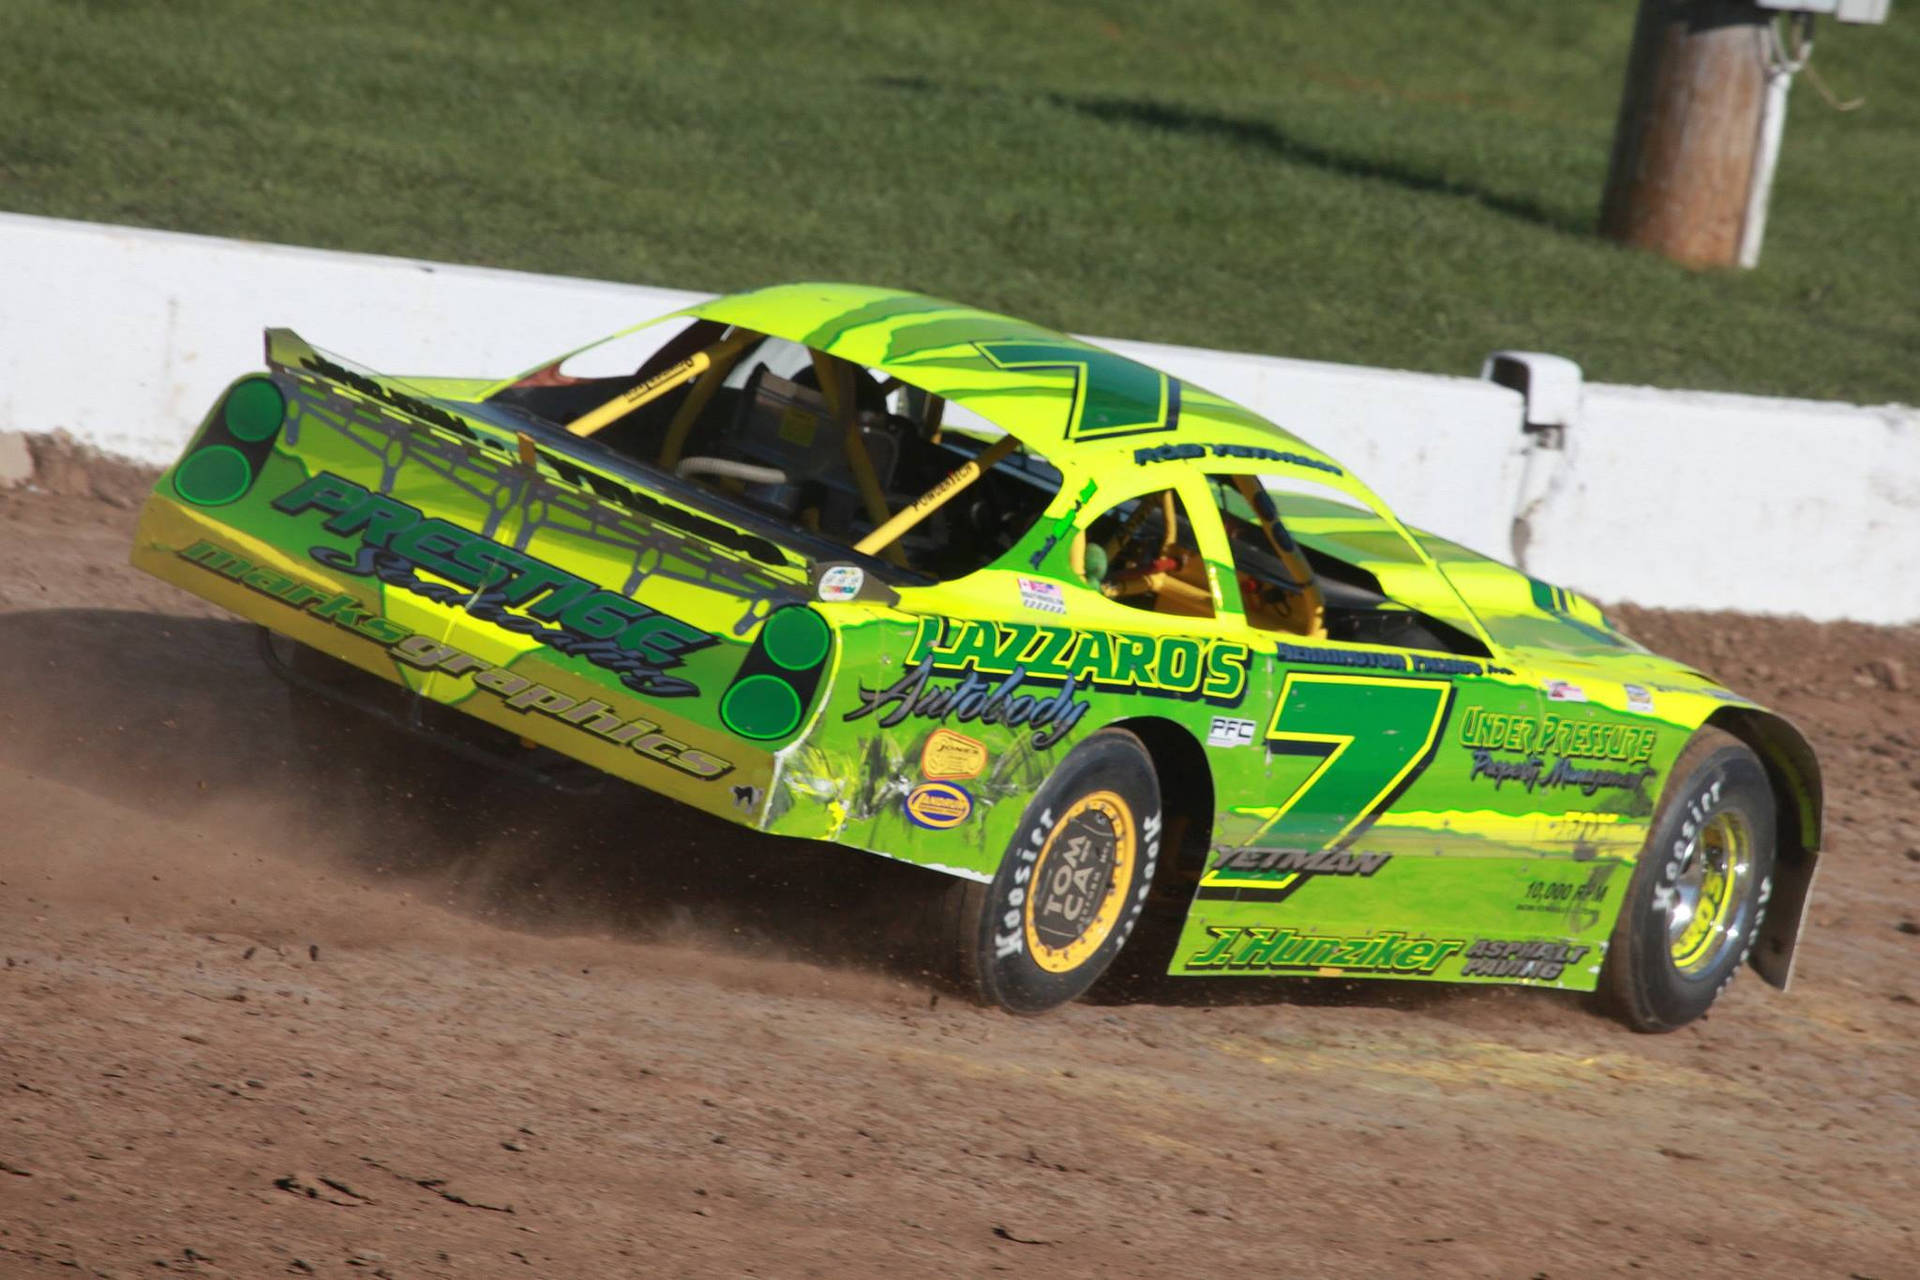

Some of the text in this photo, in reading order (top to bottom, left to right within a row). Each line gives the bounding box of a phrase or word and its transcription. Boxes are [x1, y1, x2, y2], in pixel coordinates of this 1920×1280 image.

[969, 340, 1181, 443] 7
[271, 470, 721, 668] PRESTIGE
[904, 616, 1251, 704] LAZZARO'S
[843, 657, 1091, 751] Autobody
[1211, 718, 1256, 738] PFC
[1459, 706, 1658, 764] UNDER PRESSURE
[1198, 671, 1457, 902] 7
[1043, 835, 1088, 916] TOM
[1211, 845, 1393, 877] YETMAN
[1461, 958, 1565, 981] PAVING
[1465, 939, 1591, 964] ASPHALT
